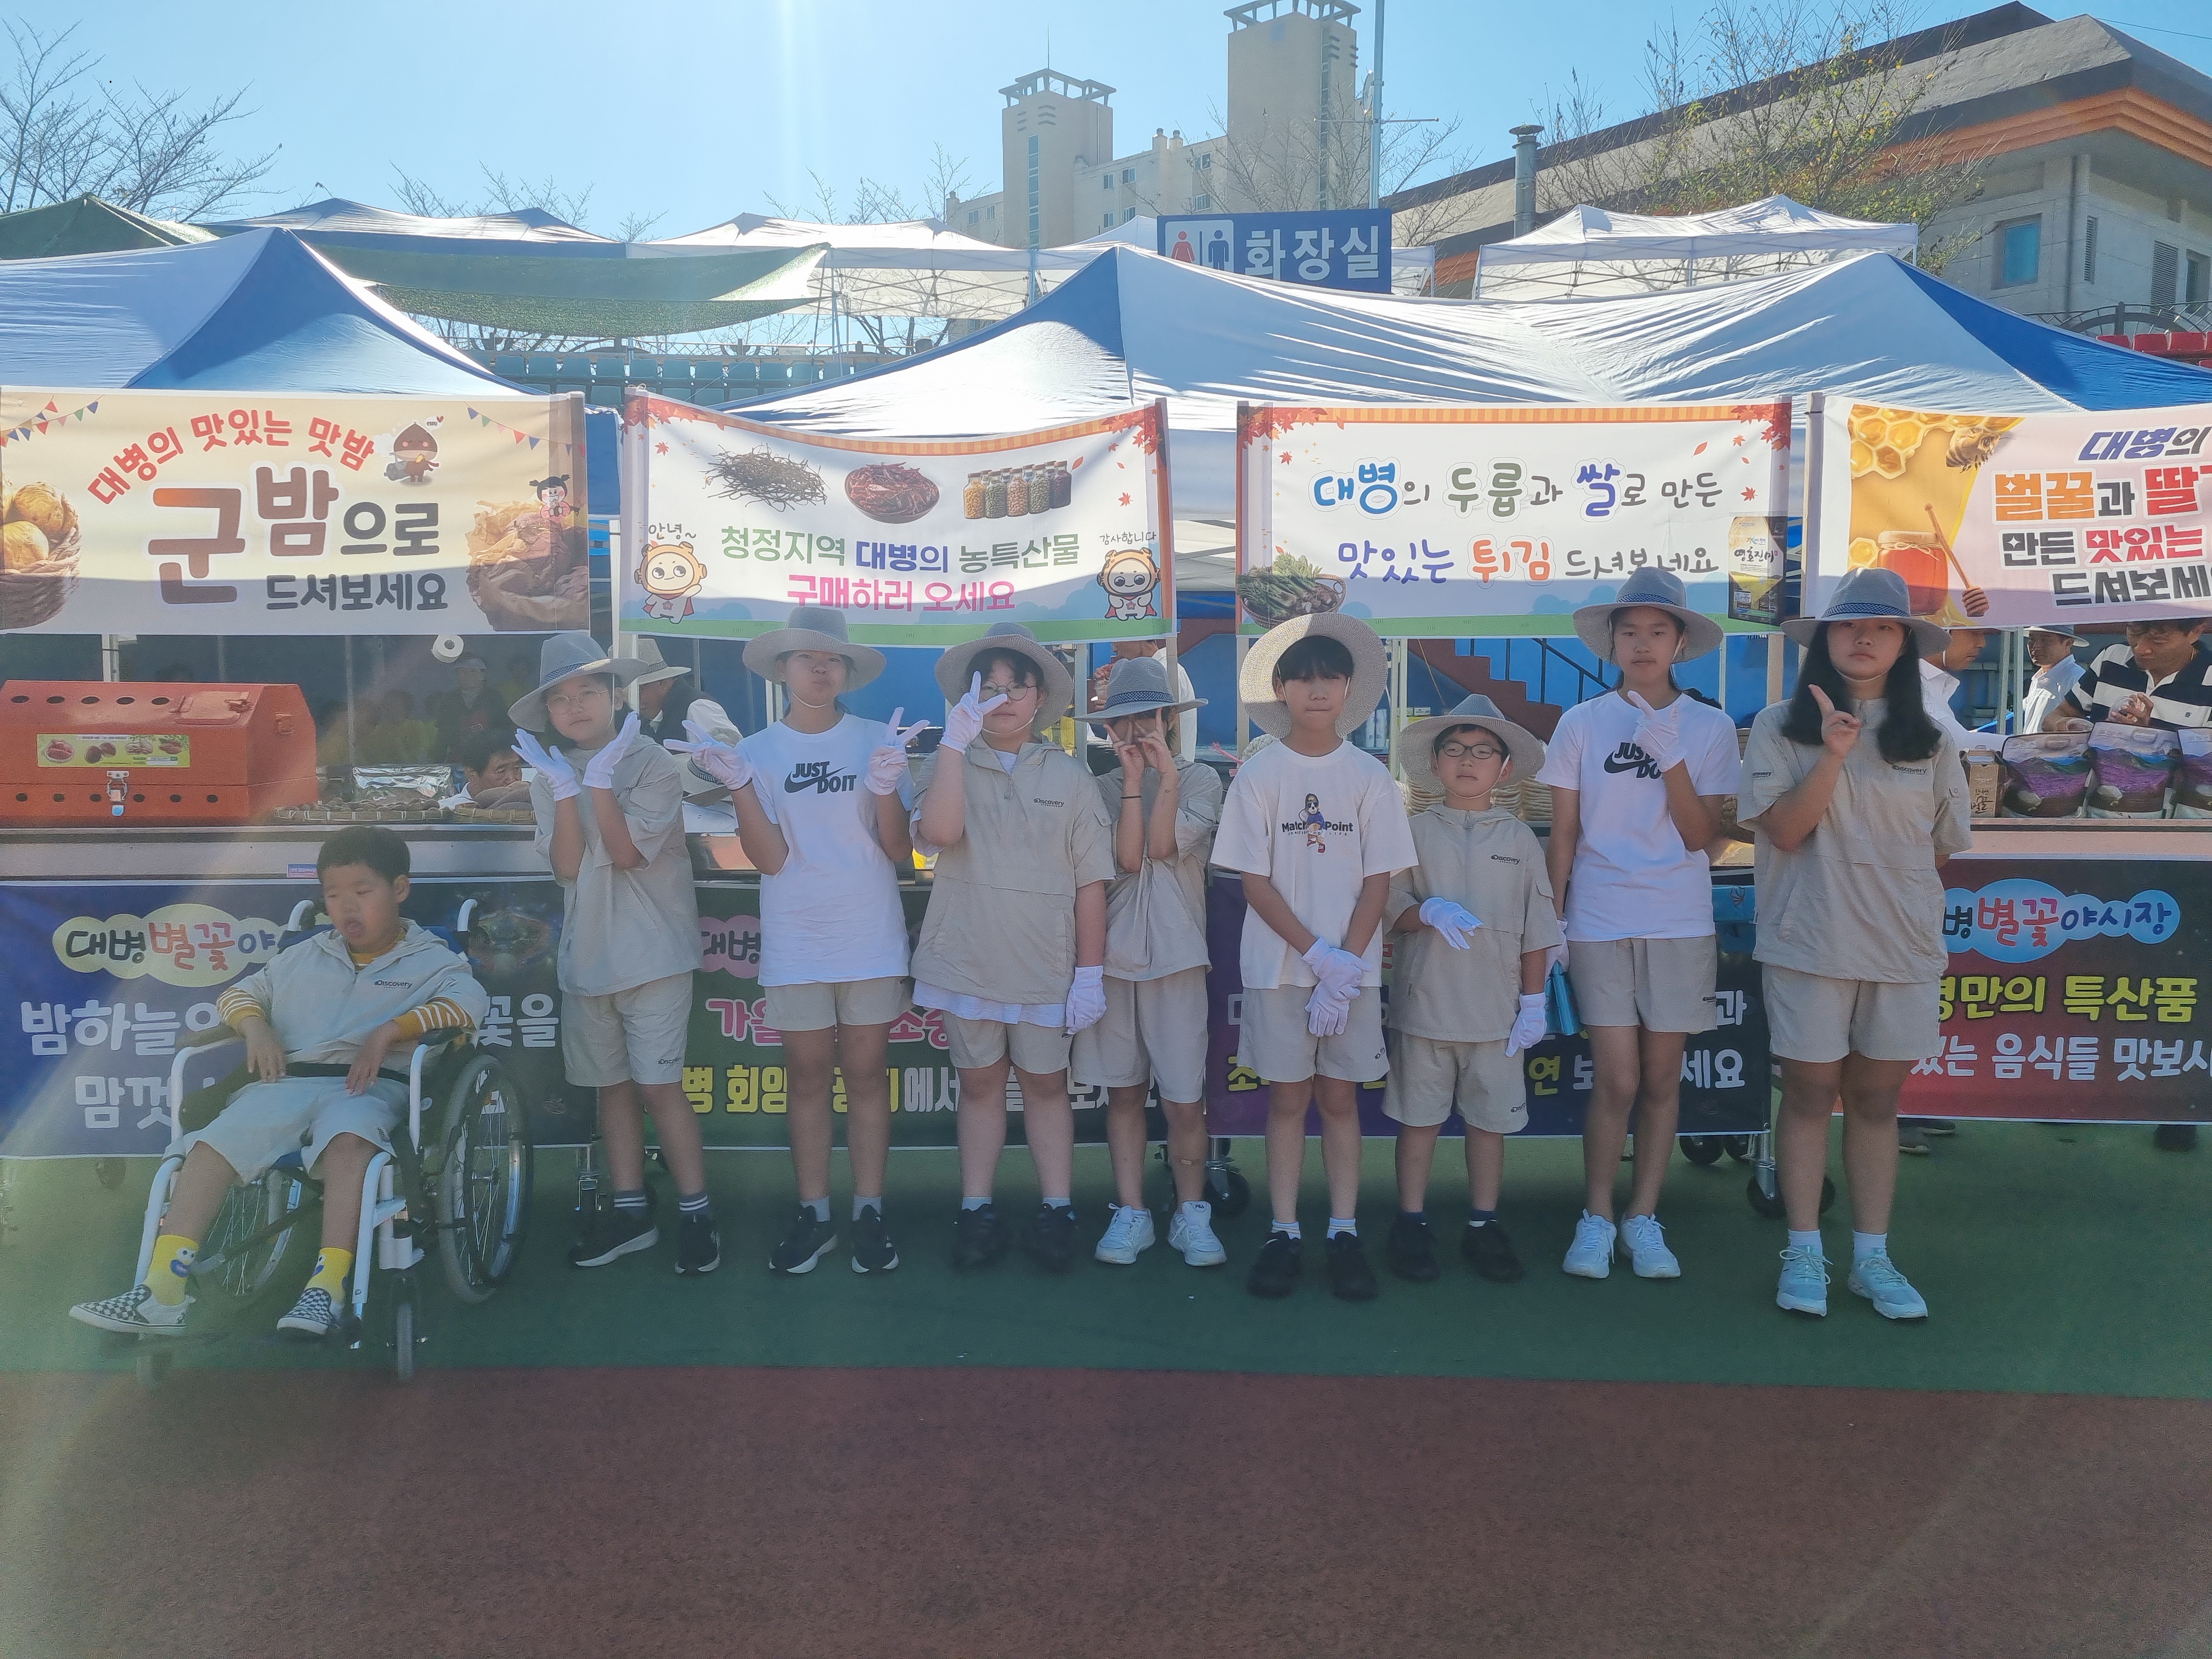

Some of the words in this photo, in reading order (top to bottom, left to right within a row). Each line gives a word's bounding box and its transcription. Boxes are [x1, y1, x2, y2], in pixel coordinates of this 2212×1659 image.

[1245, 225, 1379, 281] 화장실
[88, 426, 184, 505] 대병의
[191, 409, 291, 452] 맛있는
[307, 417, 375, 471] 맛밤
[2078, 427, 2212, 461] 대병의
[1314, 462, 1430, 514] 대병의
[1448, 462, 1563, 517] 두릅과
[1577, 463, 1646, 517] 쌀로
[1662, 471, 1723, 509] 만든
[1995, 472, 2135, 521] 벌꿀과
[2145, 465, 2212, 516] 딸
[148, 466, 439, 605] 군밤으로
[720, 526, 846, 567] 청정지역
[856, 541, 949, 573] 대병의
[958, 533, 1080, 574] 농특산물
[1098, 530, 1156, 545] 감사합니다
[2002, 532, 2075, 566] 만든
[2086, 527, 2202, 563] 맛있는
[1338, 539, 1454, 583] 맛있는
[1472, 539, 1550, 581] 튀김
[266, 573, 448, 610] 드셔보세요
[787, 573, 913, 612] 구매하러
[924, 581, 1016, 612] 오세요
[2052, 565, 2212, 606] 드셔보세
[793, 761, 830, 778] JUST
[1325, 821, 1353, 832] Point
[65, 922, 276, 970] 대병별꽃야
[374, 980, 413, 989] Discovery
[2063, 975, 2198, 1022] 특산품
[1991, 1033, 2100, 1081] 음식들
